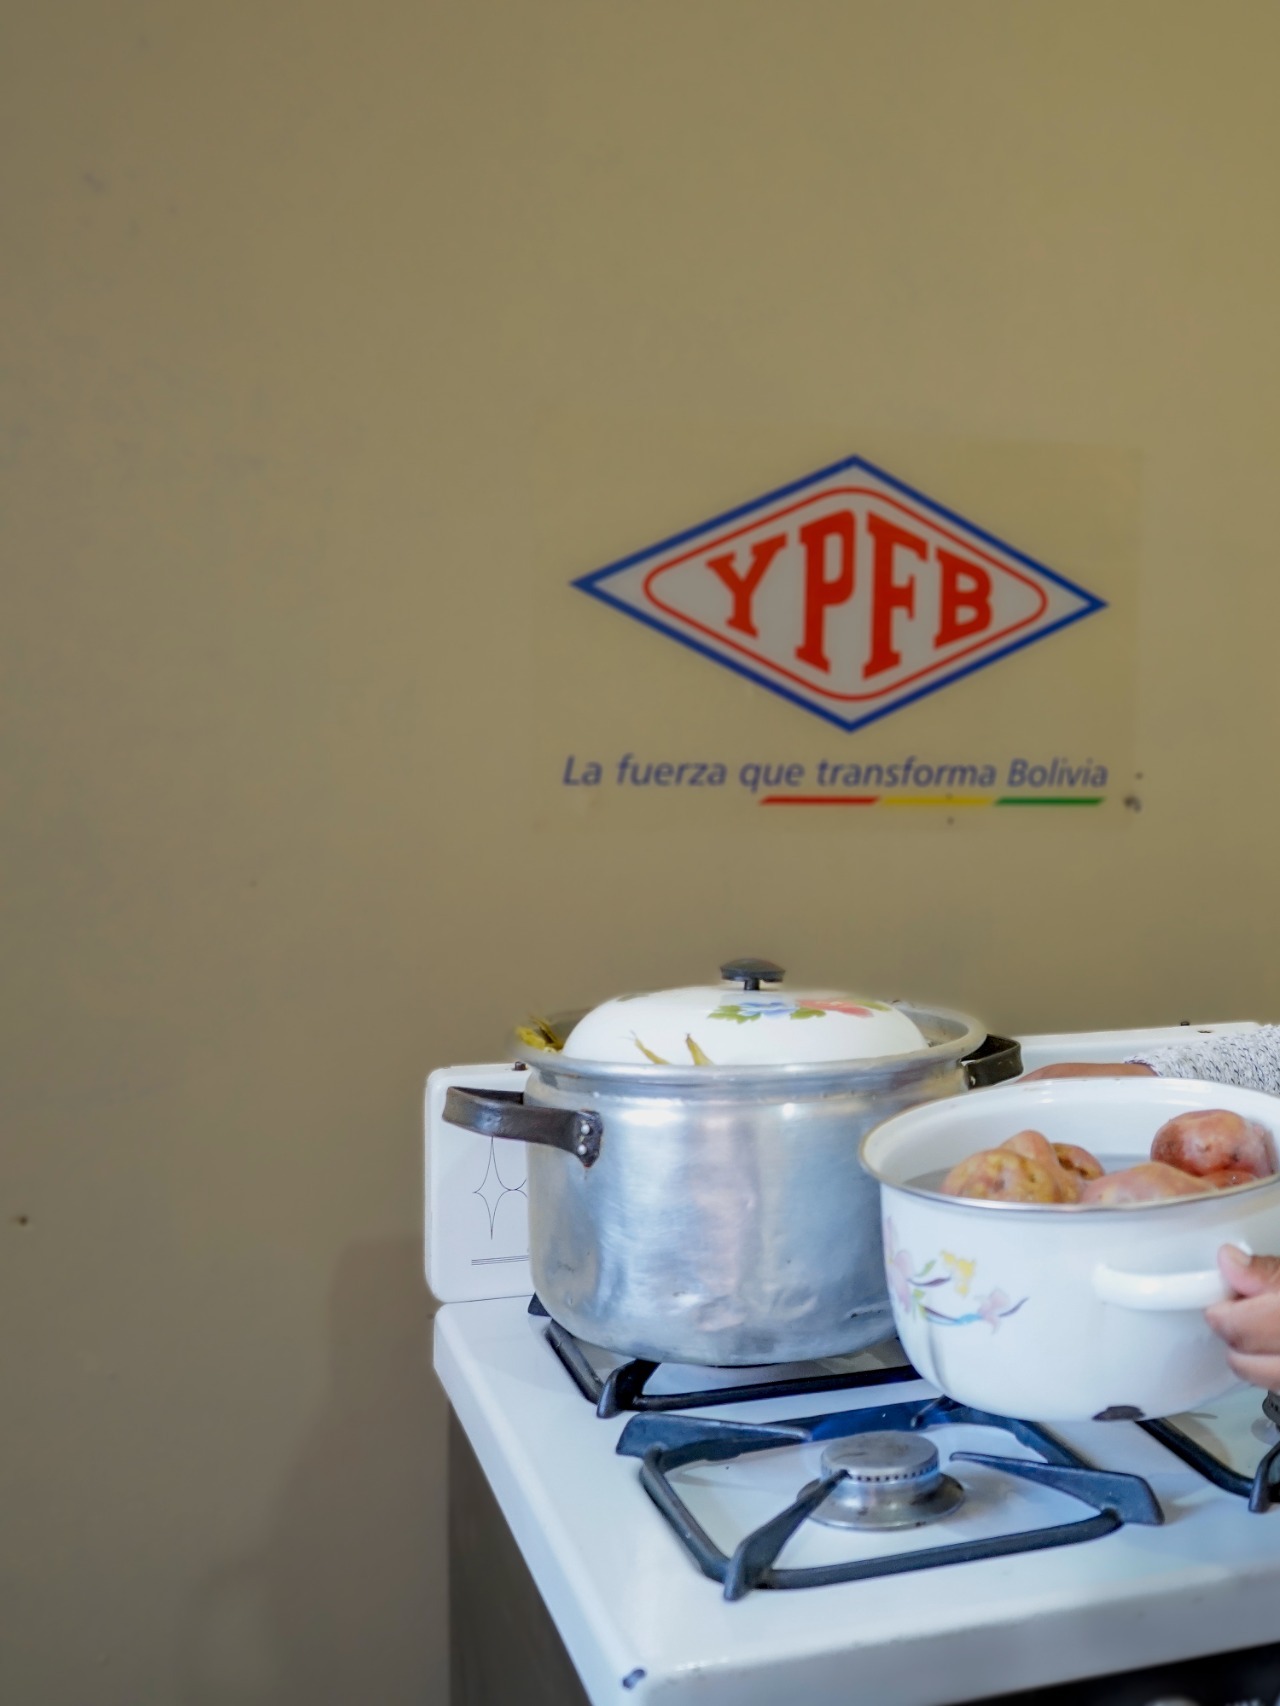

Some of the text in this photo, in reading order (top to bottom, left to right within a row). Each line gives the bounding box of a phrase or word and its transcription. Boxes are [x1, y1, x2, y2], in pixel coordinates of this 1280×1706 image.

[705, 509, 993, 680] YPFB
[562, 752, 1109, 793] La fuerza que transforma Bolivia
